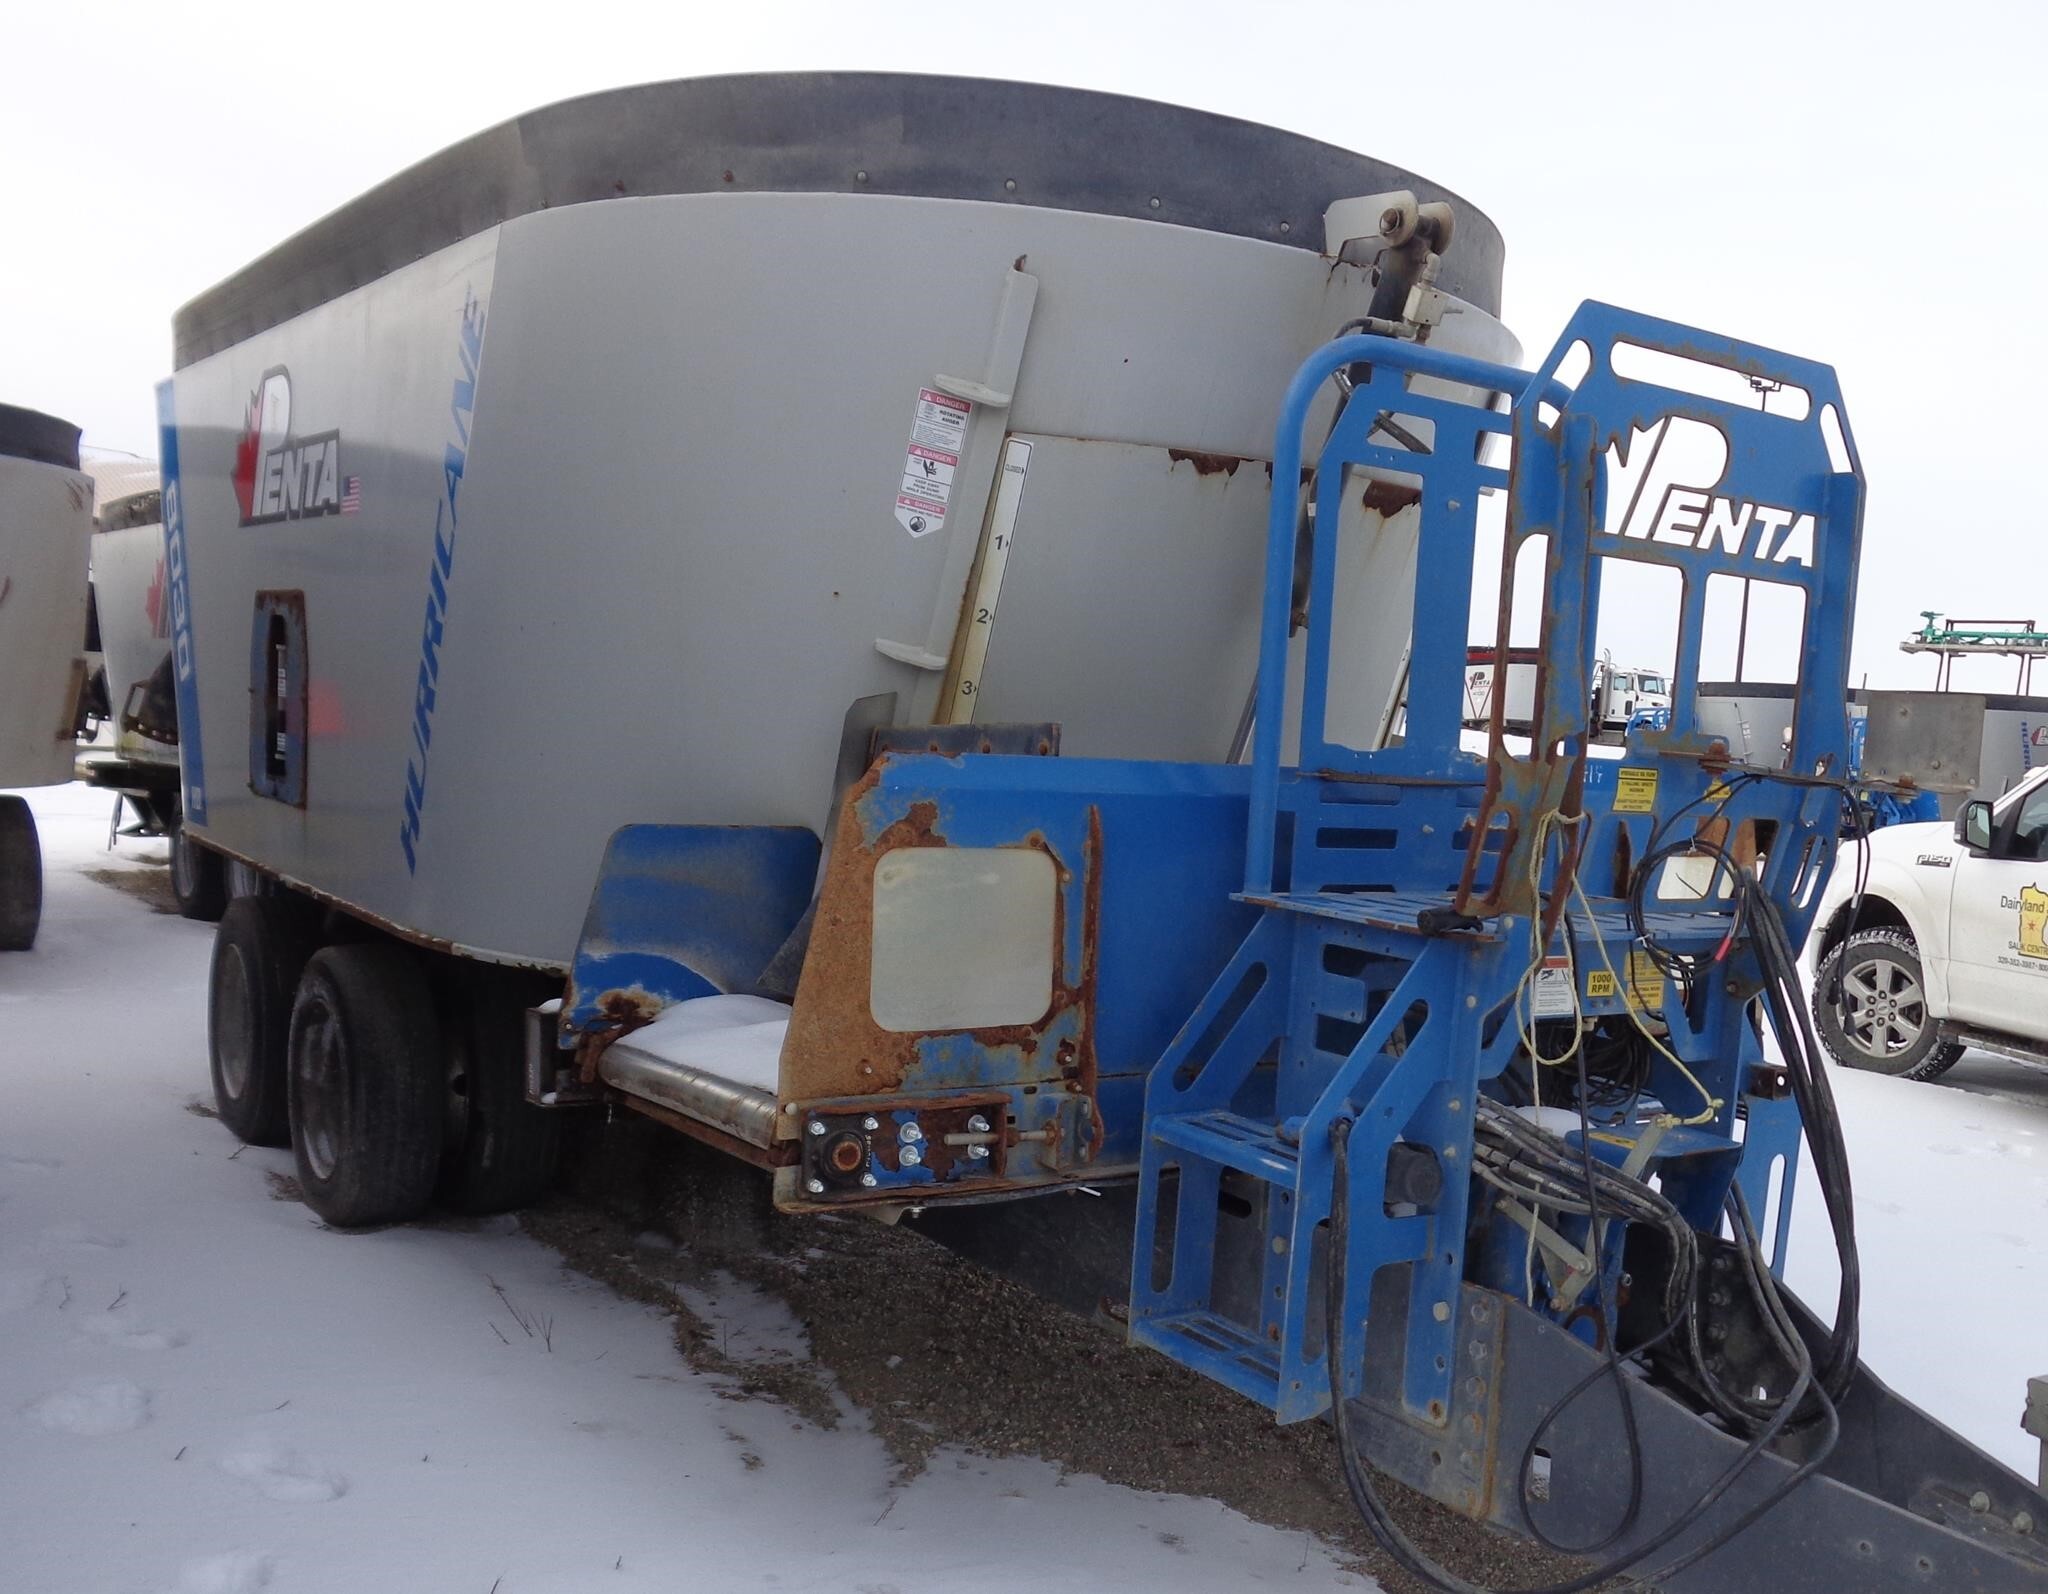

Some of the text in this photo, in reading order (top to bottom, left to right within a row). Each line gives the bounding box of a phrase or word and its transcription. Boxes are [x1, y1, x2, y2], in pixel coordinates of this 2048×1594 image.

[936, 396, 966, 409] DANGER
[942, 417, 960, 425] AUGER
[248, 367, 339, 519] PENTA
[923, 449, 952, 462] DANGER
[1624, 416, 1815, 567] PENTA
[914, 500, 941, 512] DANGER
[994, 535, 1004, 550] 1
[400, 300, 485, 876] HURRICANE
[976, 608, 989, 624] 2
[961, 680, 973, 695] 3
[2000, 895, 2045, 913] Dairyland
[1592, 974, 1612, 983] 1000
[1591, 984, 1610, 993] RPM
